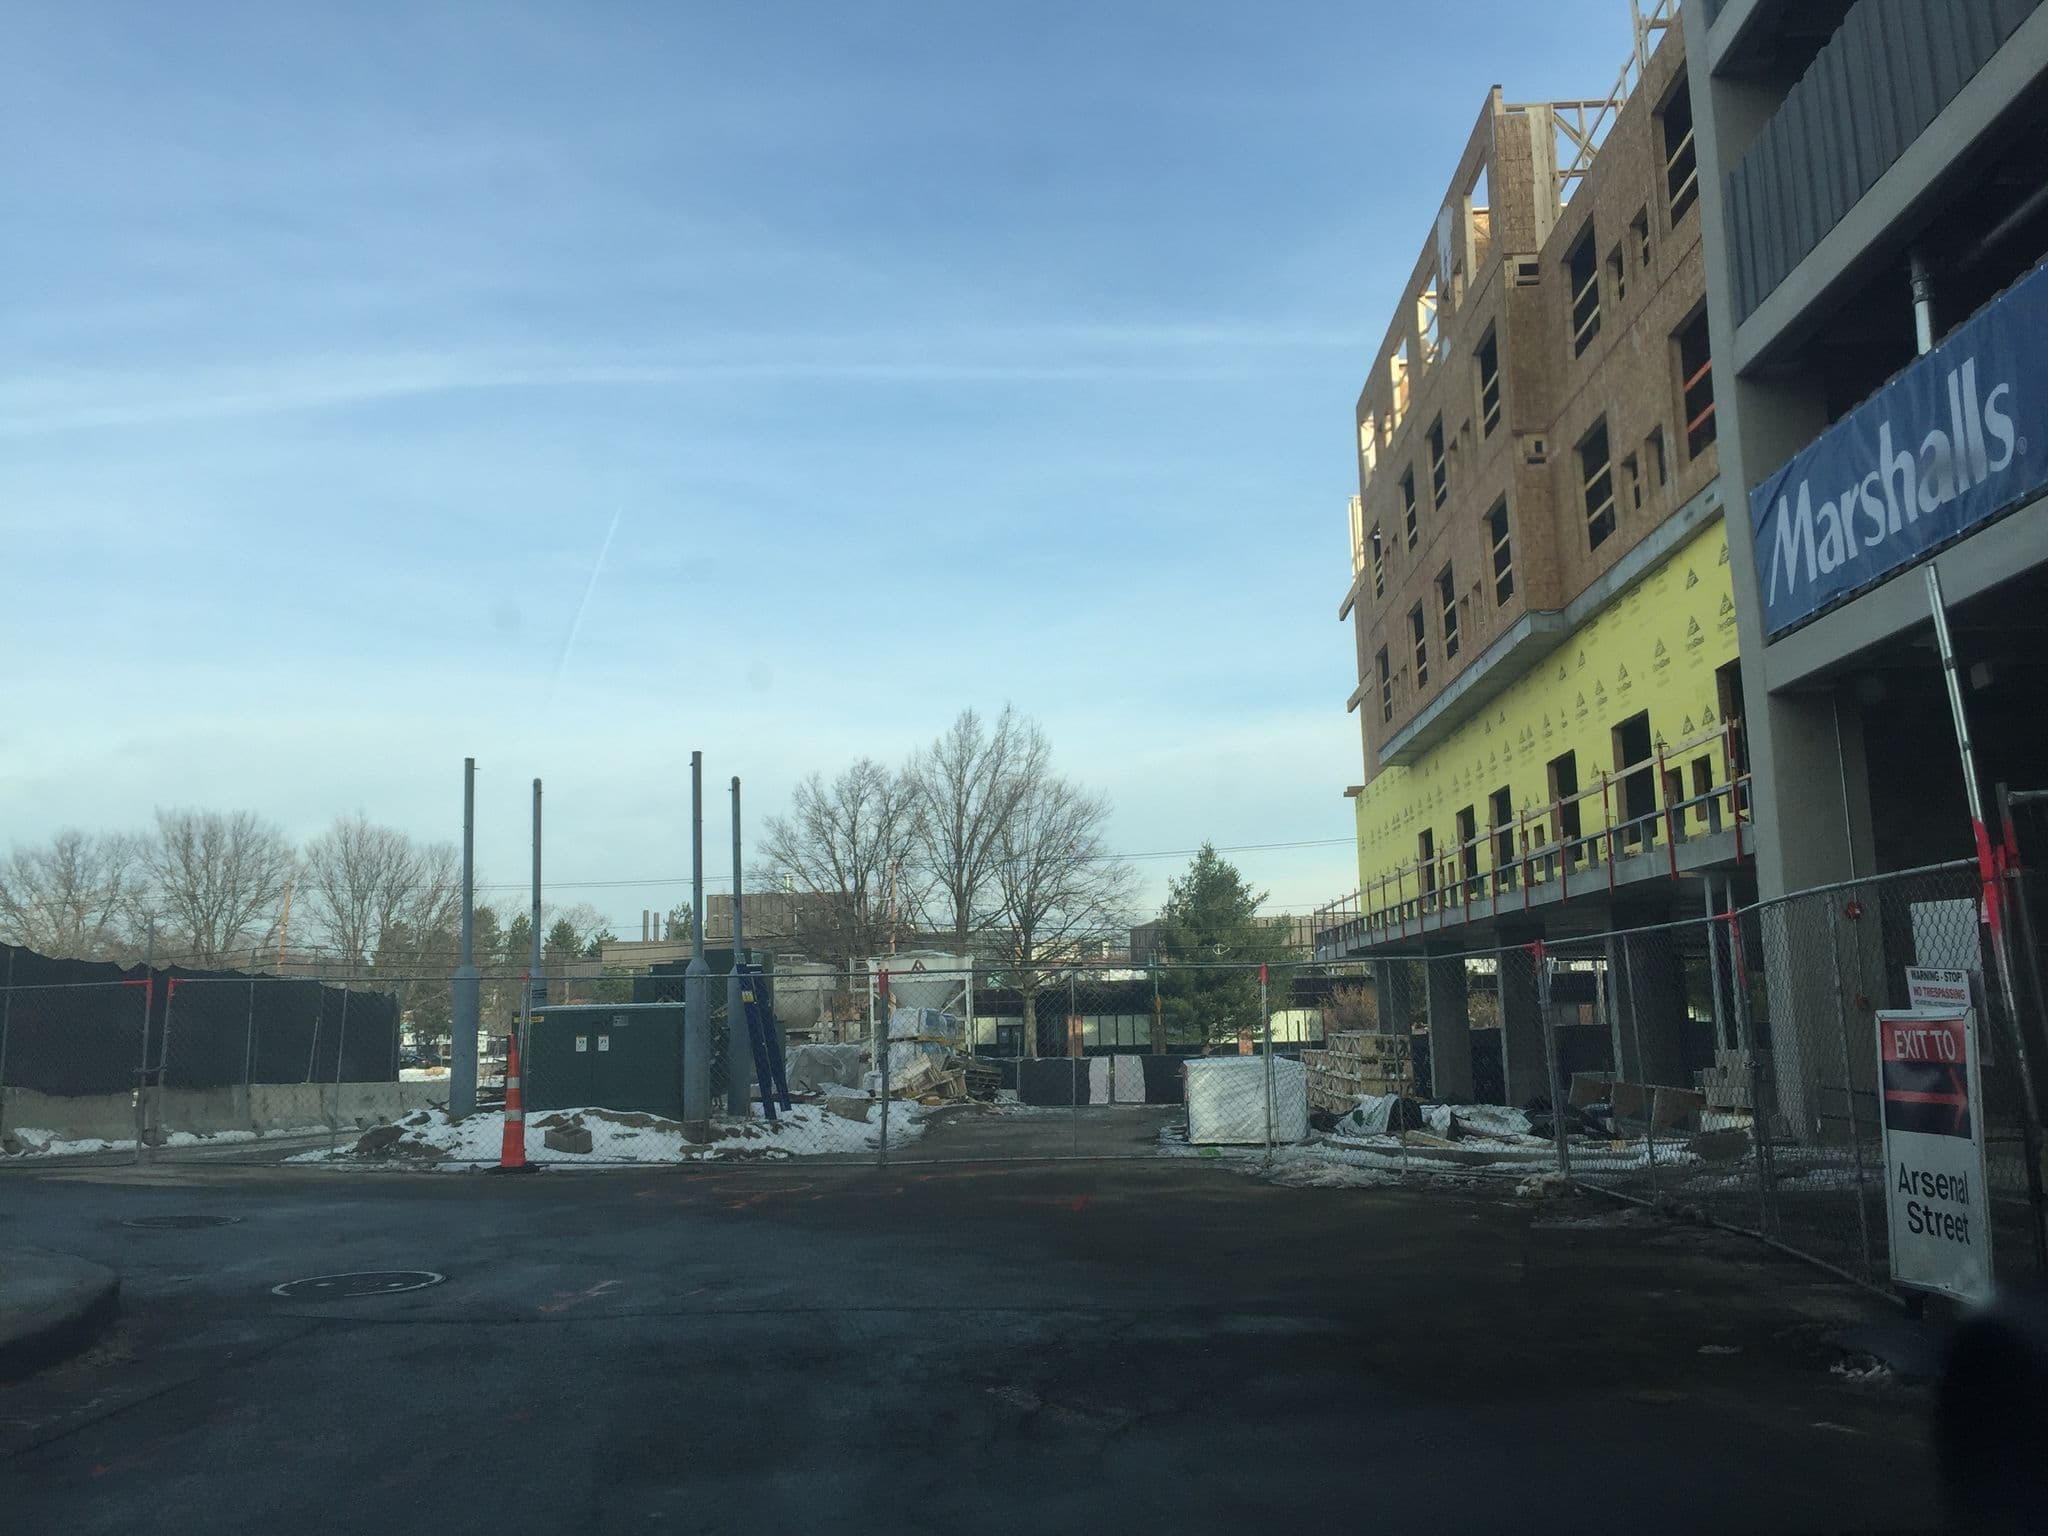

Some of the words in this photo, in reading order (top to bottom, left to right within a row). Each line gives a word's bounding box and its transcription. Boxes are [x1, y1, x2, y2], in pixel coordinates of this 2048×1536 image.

[1769, 356, 2015, 607] Marshalls
[1911, 970, 1939, 982] WARNING
[1913, 986, 1922, 997] NO
[1922, 987, 1966, 1001] TRESPASSING
[1894, 1030, 1928, 1059] EXIT
[1930, 1030, 1956, 1060] TO
[1898, 1162, 1970, 1205] Arsenal
[1907, 1201, 1971, 1246] Street
